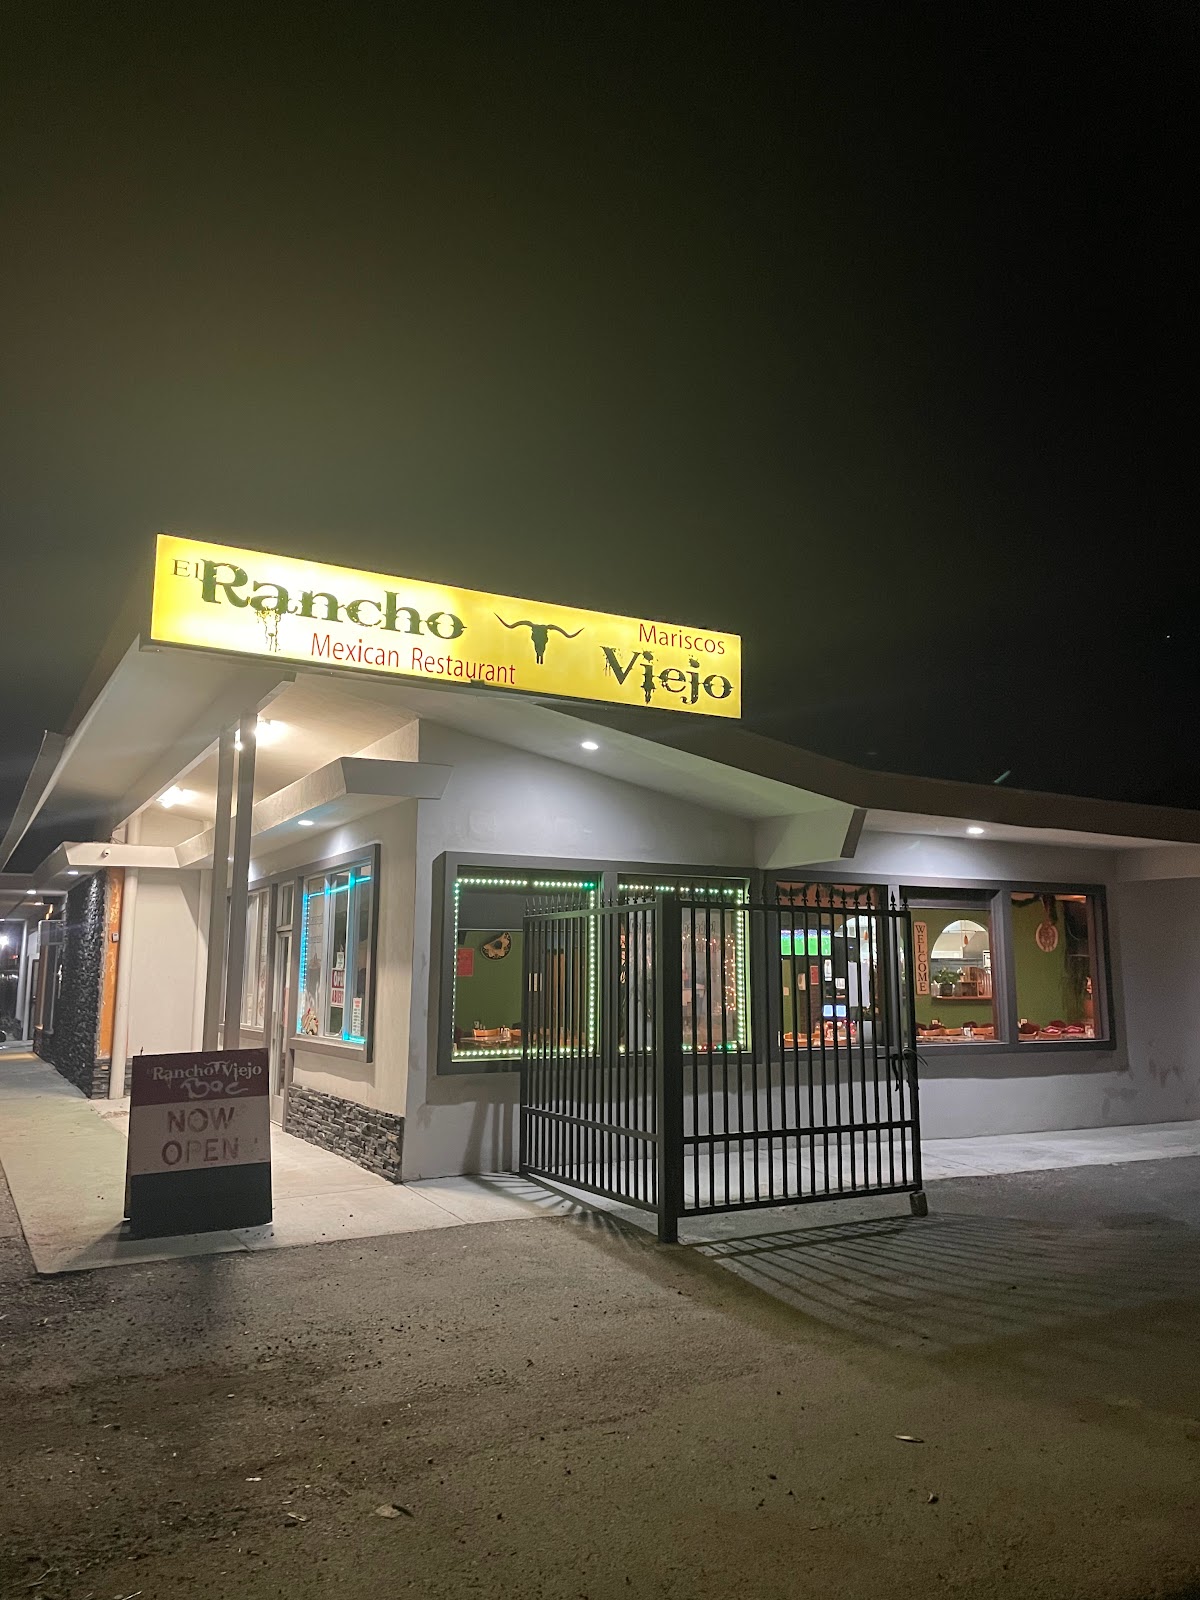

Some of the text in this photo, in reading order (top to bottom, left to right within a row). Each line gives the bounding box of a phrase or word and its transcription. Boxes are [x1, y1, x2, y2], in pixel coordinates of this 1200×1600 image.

[171, 558, 467, 640] El Rancho
[638, 622, 726, 655] Mariscos
[311, 632, 516, 685] Mexican Restaurant
[599, 645, 735, 705] Viejo
[914, 924, 929, 992] WELCOME
[333, 970, 345, 987] OPE
[152, 1064, 214, 1081] Rancho
[221, 1062, 263, 1082] Viejo
[167, 1106, 235, 1133] NOW
[161, 1137, 240, 1166] OPEN
